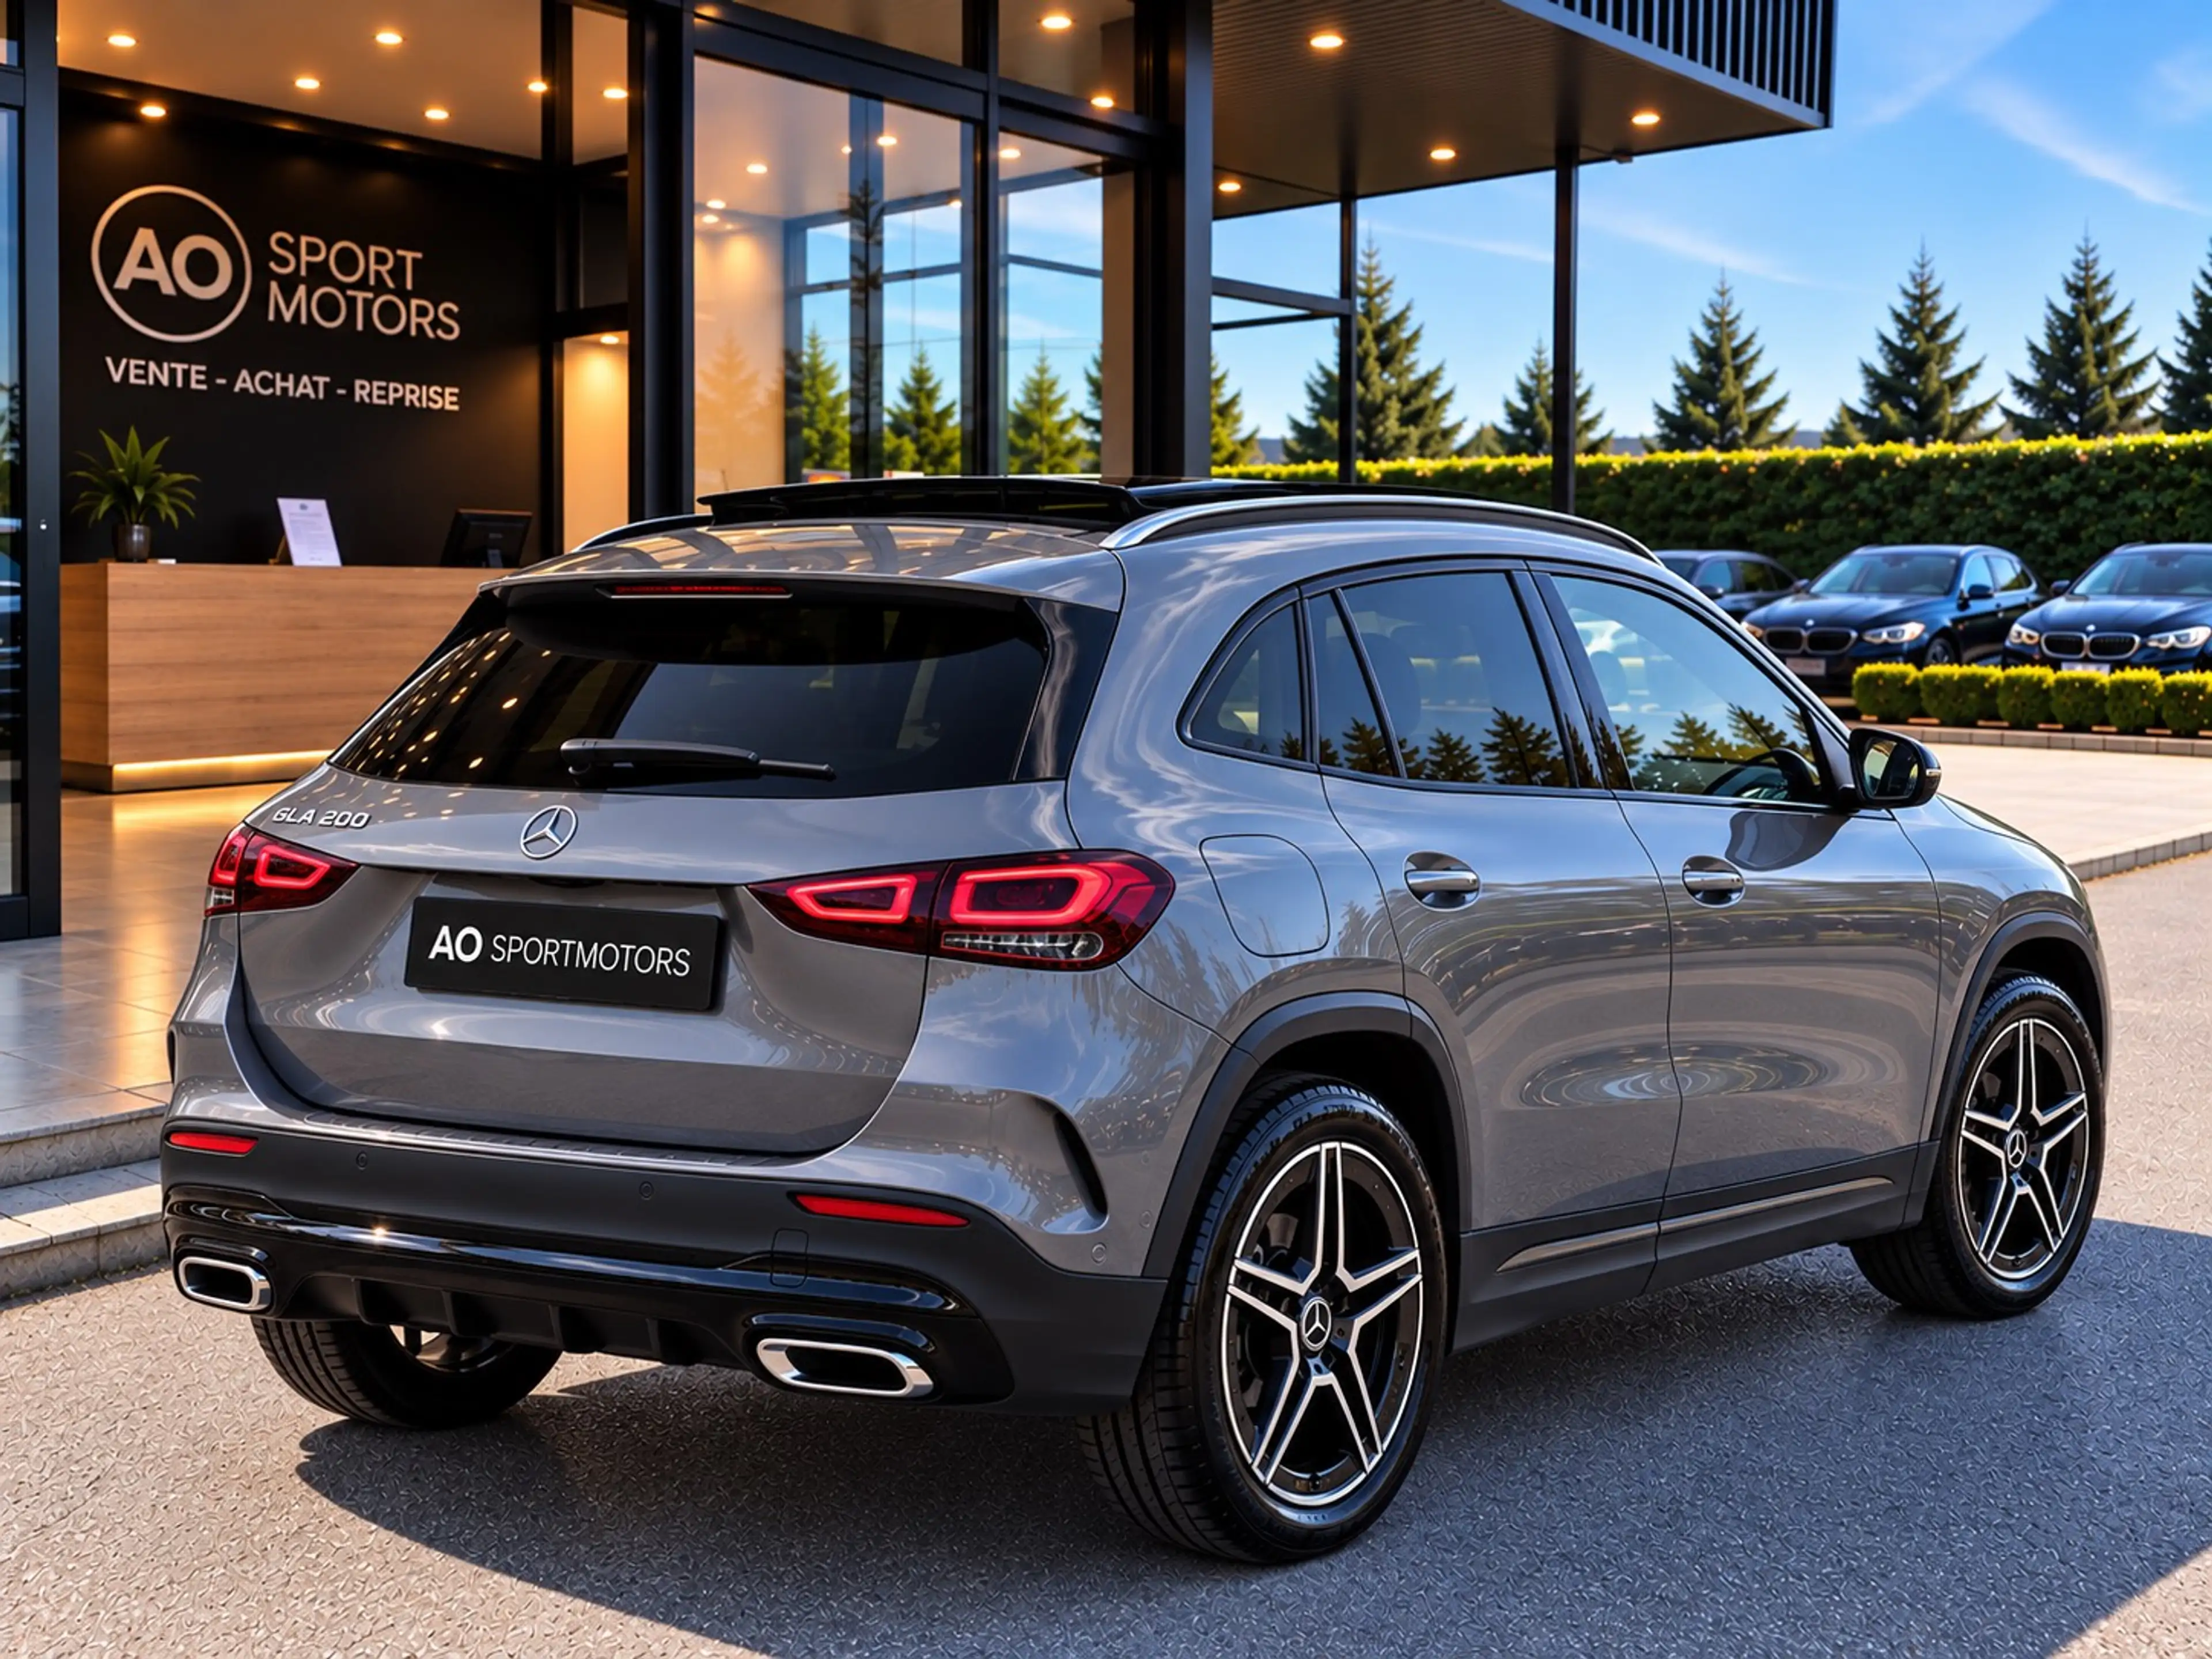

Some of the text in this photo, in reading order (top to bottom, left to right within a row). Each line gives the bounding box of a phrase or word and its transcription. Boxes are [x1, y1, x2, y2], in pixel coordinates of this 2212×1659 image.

[113, 227, 233, 300] AO
[268, 231, 422, 290] SPORT
[268, 281, 460, 340] MOTORS
[104, 355, 209, 391] VENTE
[233, 368, 331, 401] ACHAT
[354, 378, 460, 412] REPRISE
[272, 808, 371, 828] GLA 200
[427, 925, 691, 976] AO SPORTMOTORS
